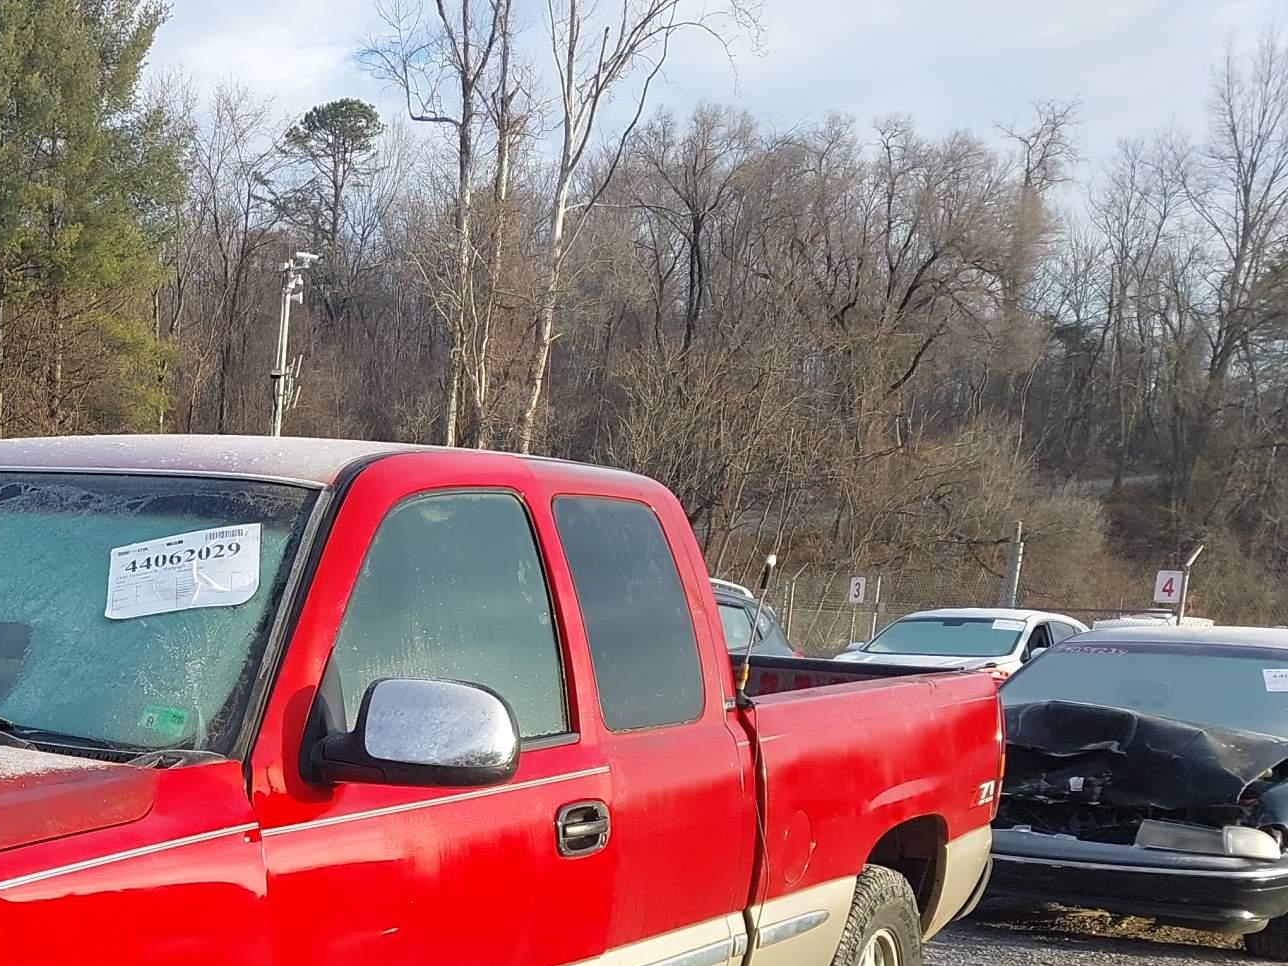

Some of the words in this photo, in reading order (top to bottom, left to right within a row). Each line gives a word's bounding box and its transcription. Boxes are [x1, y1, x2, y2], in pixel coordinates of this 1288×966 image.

[125, 542, 241, 573] 44062029
[854, 582, 861, 598] 3
[1162, 577, 1174, 597] 4
